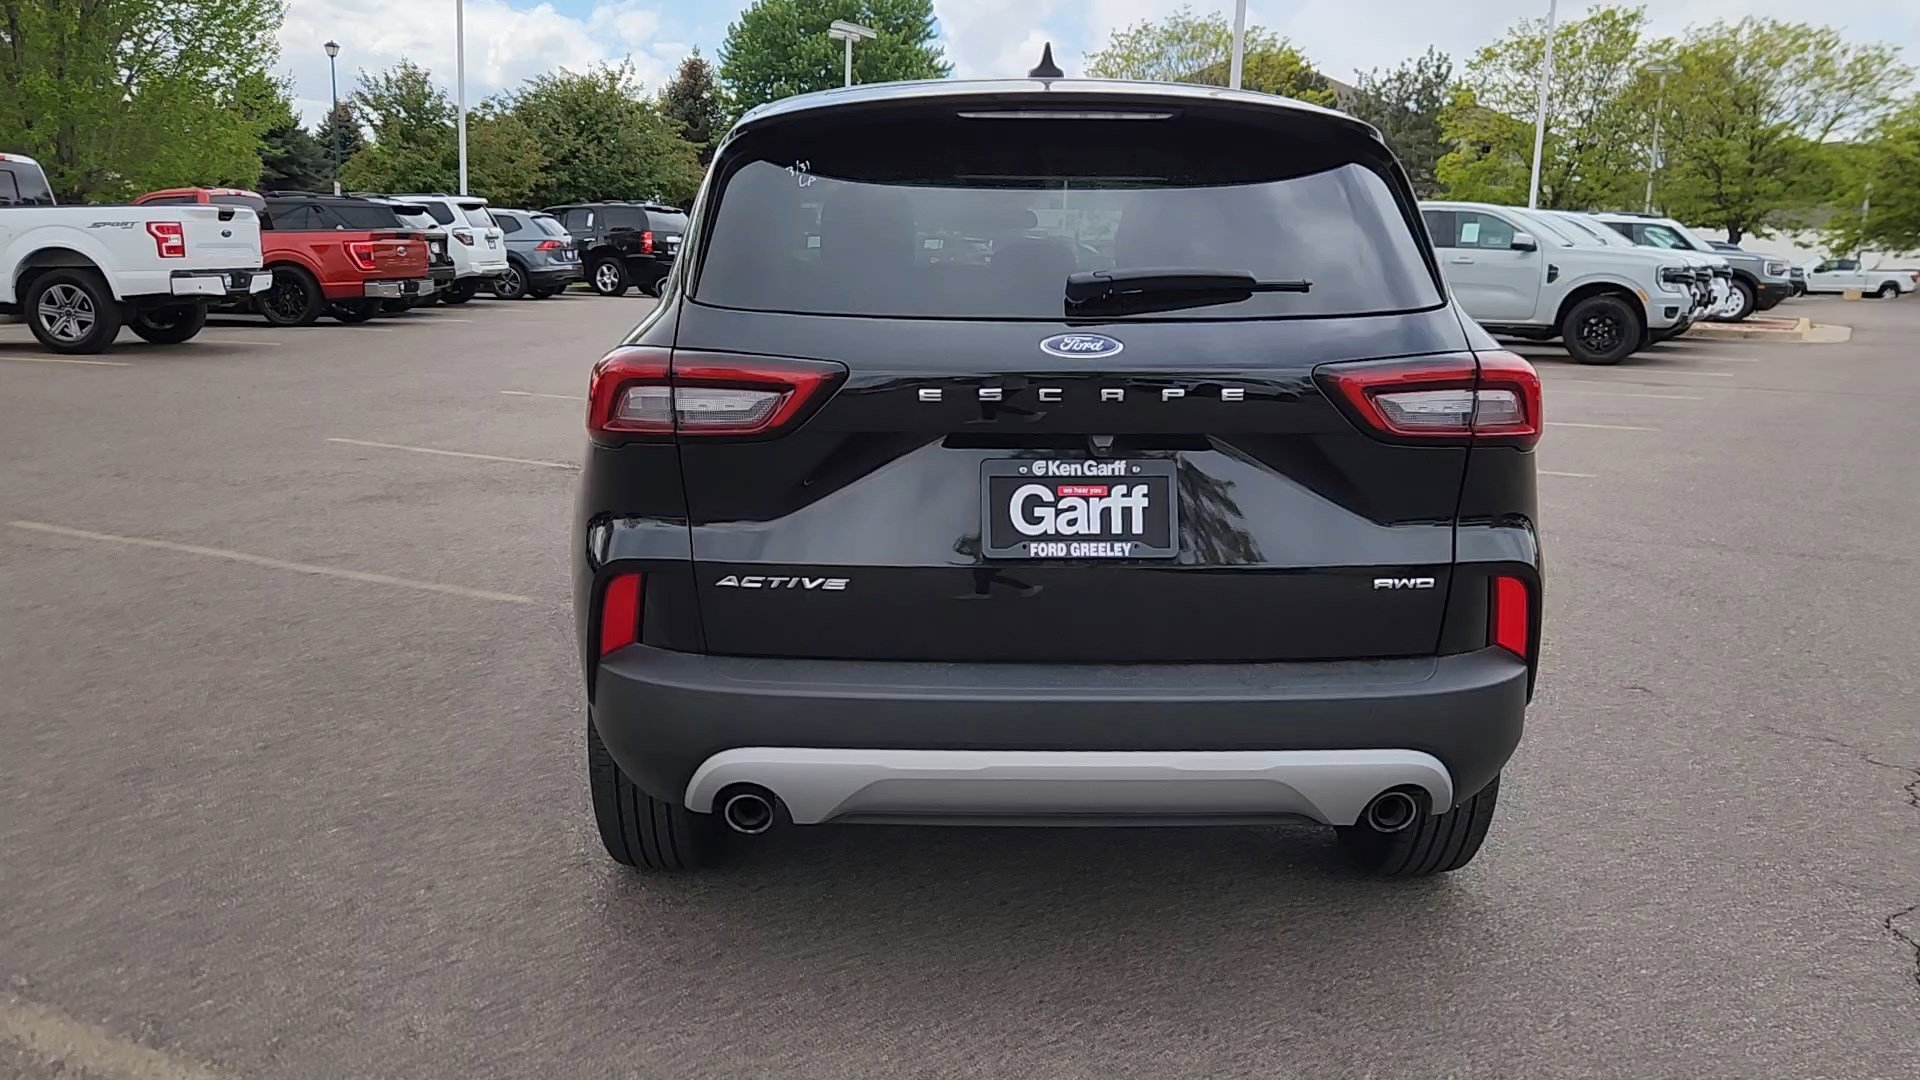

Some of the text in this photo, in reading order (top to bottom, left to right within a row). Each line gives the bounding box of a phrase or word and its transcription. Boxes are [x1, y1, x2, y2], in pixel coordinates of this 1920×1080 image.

[87, 221, 140, 229] SPORT
[1060, 336, 1105, 351] Ford
[918, 388, 1245, 402] ESCAPE
[1048, 460, 1082, 476] Ken
[1083, 460, 1127, 476] Garff
[1074, 486, 1088, 494] hear
[1090, 487, 1102, 496] you
[1010, 484, 1149, 536] Garff
[1030, 542, 1132, 557] FORD GREELEY
[715, 575, 850, 590] ACTIVE
[1374, 578, 1435, 589] AWD
